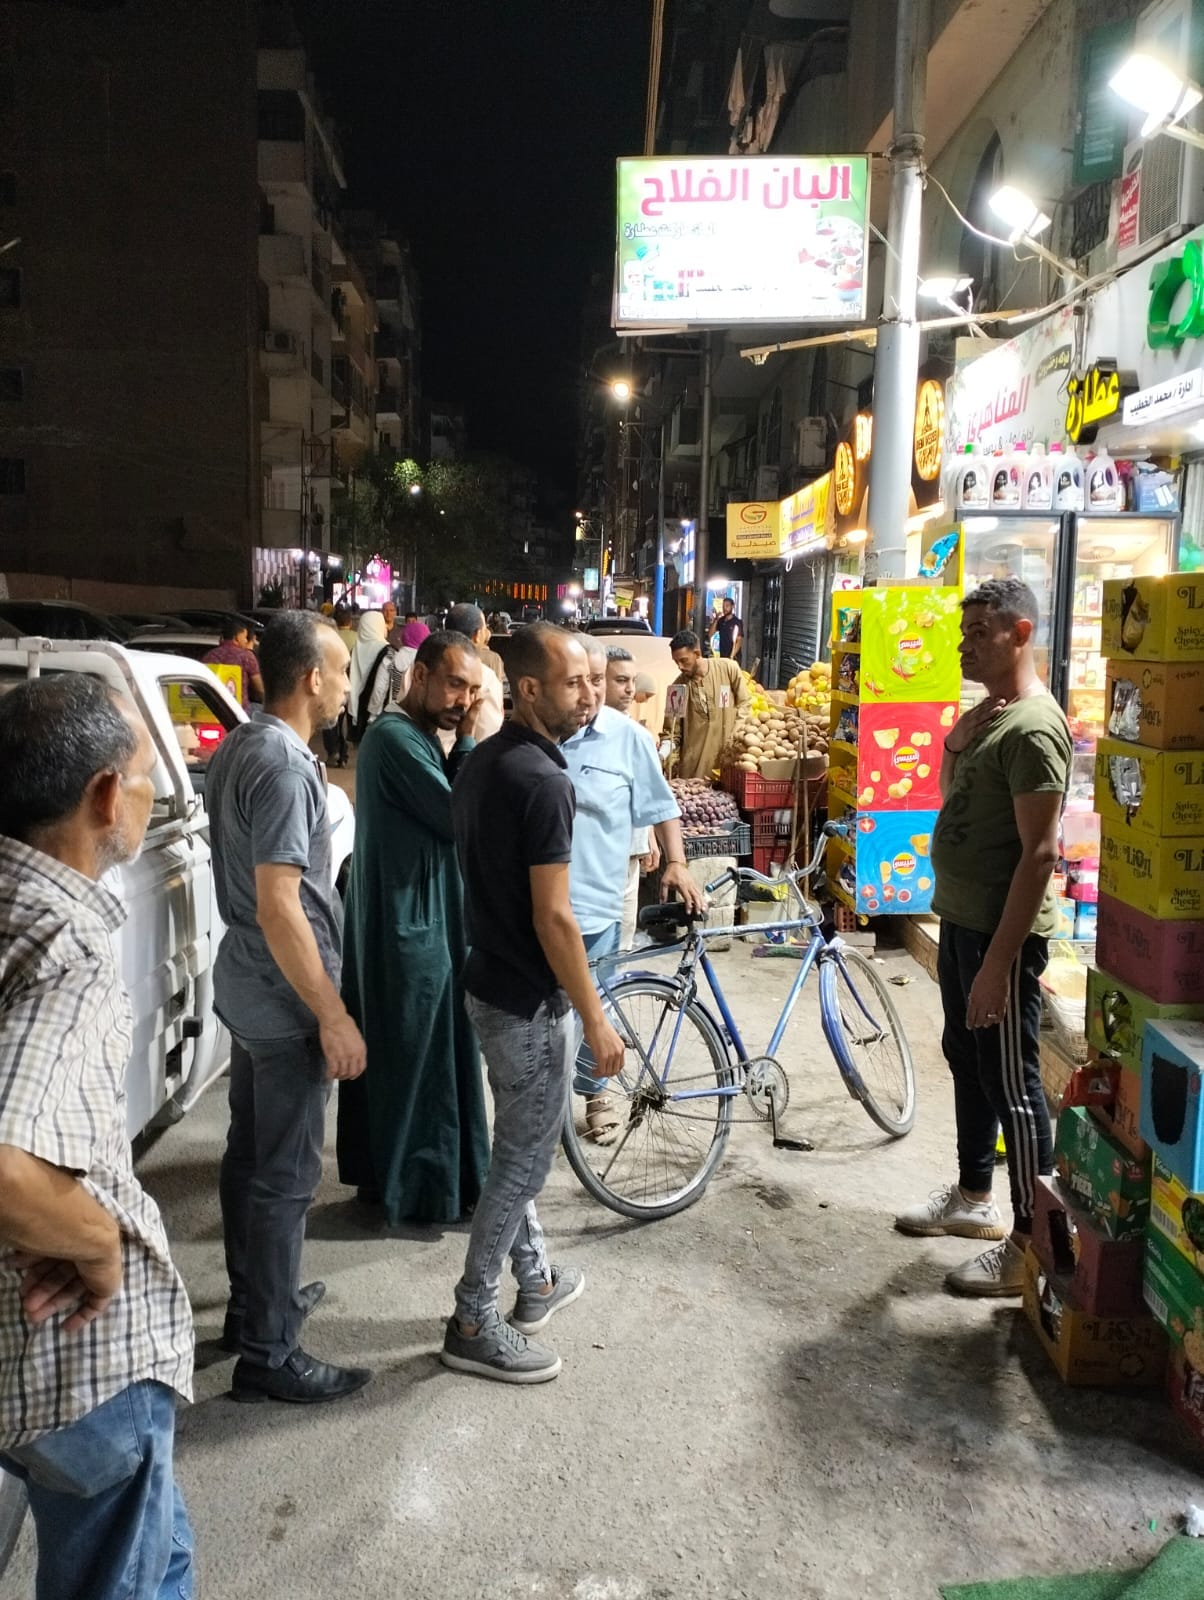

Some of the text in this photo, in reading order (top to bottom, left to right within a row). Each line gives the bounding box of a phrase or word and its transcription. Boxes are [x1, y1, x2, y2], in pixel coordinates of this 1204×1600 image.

[641, 165, 850, 216] البان الفلاح
[1065, 367, 1120, 444] عطارة
